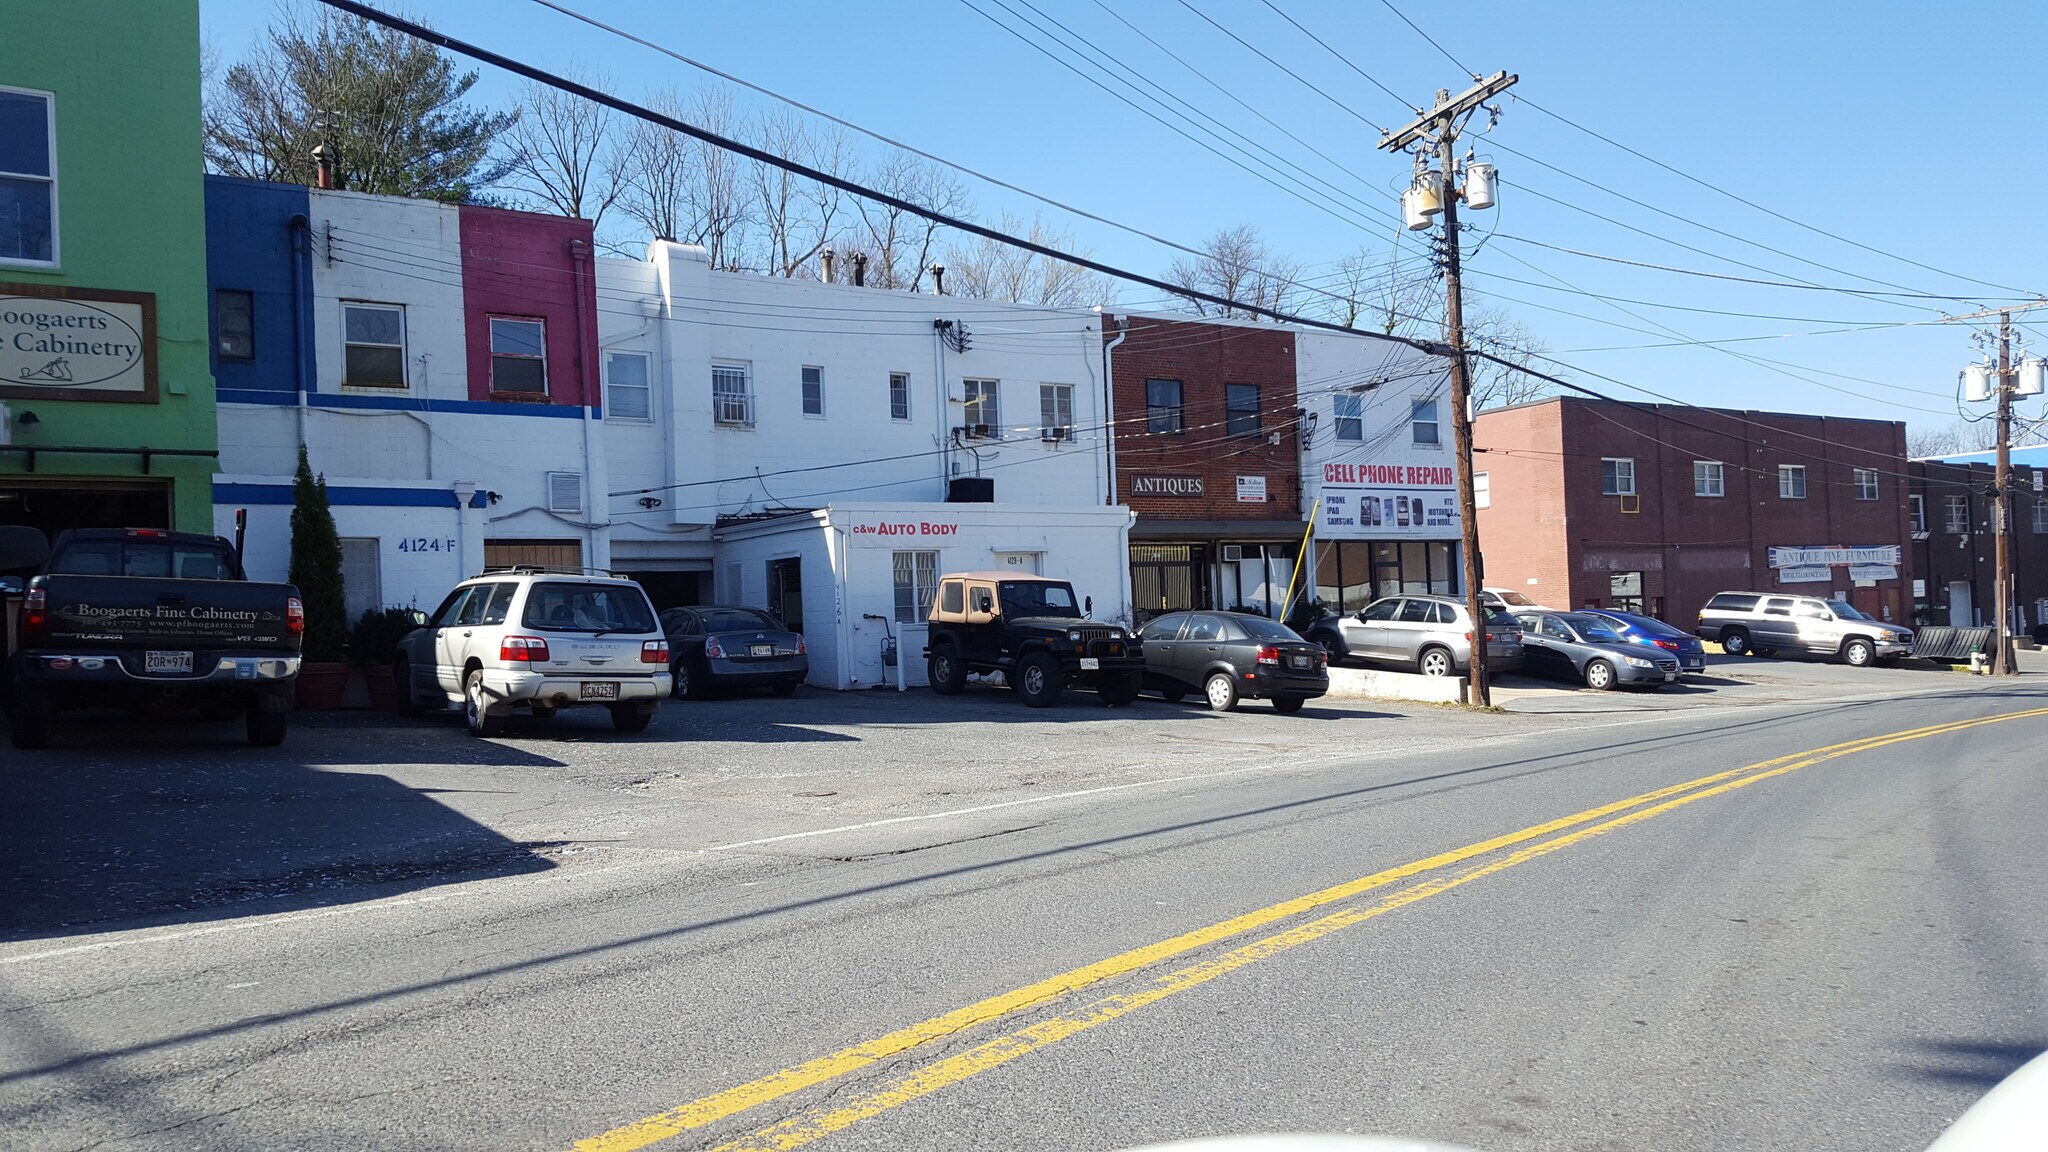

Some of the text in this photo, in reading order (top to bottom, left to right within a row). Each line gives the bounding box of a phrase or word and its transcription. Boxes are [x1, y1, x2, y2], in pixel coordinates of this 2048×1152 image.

[0, 311, 108, 331] oogaerts
[13, 332, 137, 362] Cabinetry
[1324, 463, 1453, 485] CELL PHONE REPAIR
[1134, 477, 1202, 495] ANTIQUES
[1326, 496, 1346, 504] IPHONE
[1444, 498, 1453, 506] HTC
[1327, 507, 1339, 515] IPAD
[1428, 508, 1453, 516] MOTOROLA
[1327, 517, 1354, 526] SAMSUNG
[1783, 550, 1892, 563] ANTIQUE PINE FURNITURE
[79, 603, 258, 623] Boogaerts Fine Cabinetry
[149, 619, 255, 629] www.pfboogaerts.com
[75, 632, 123, 640] TUNDRA
